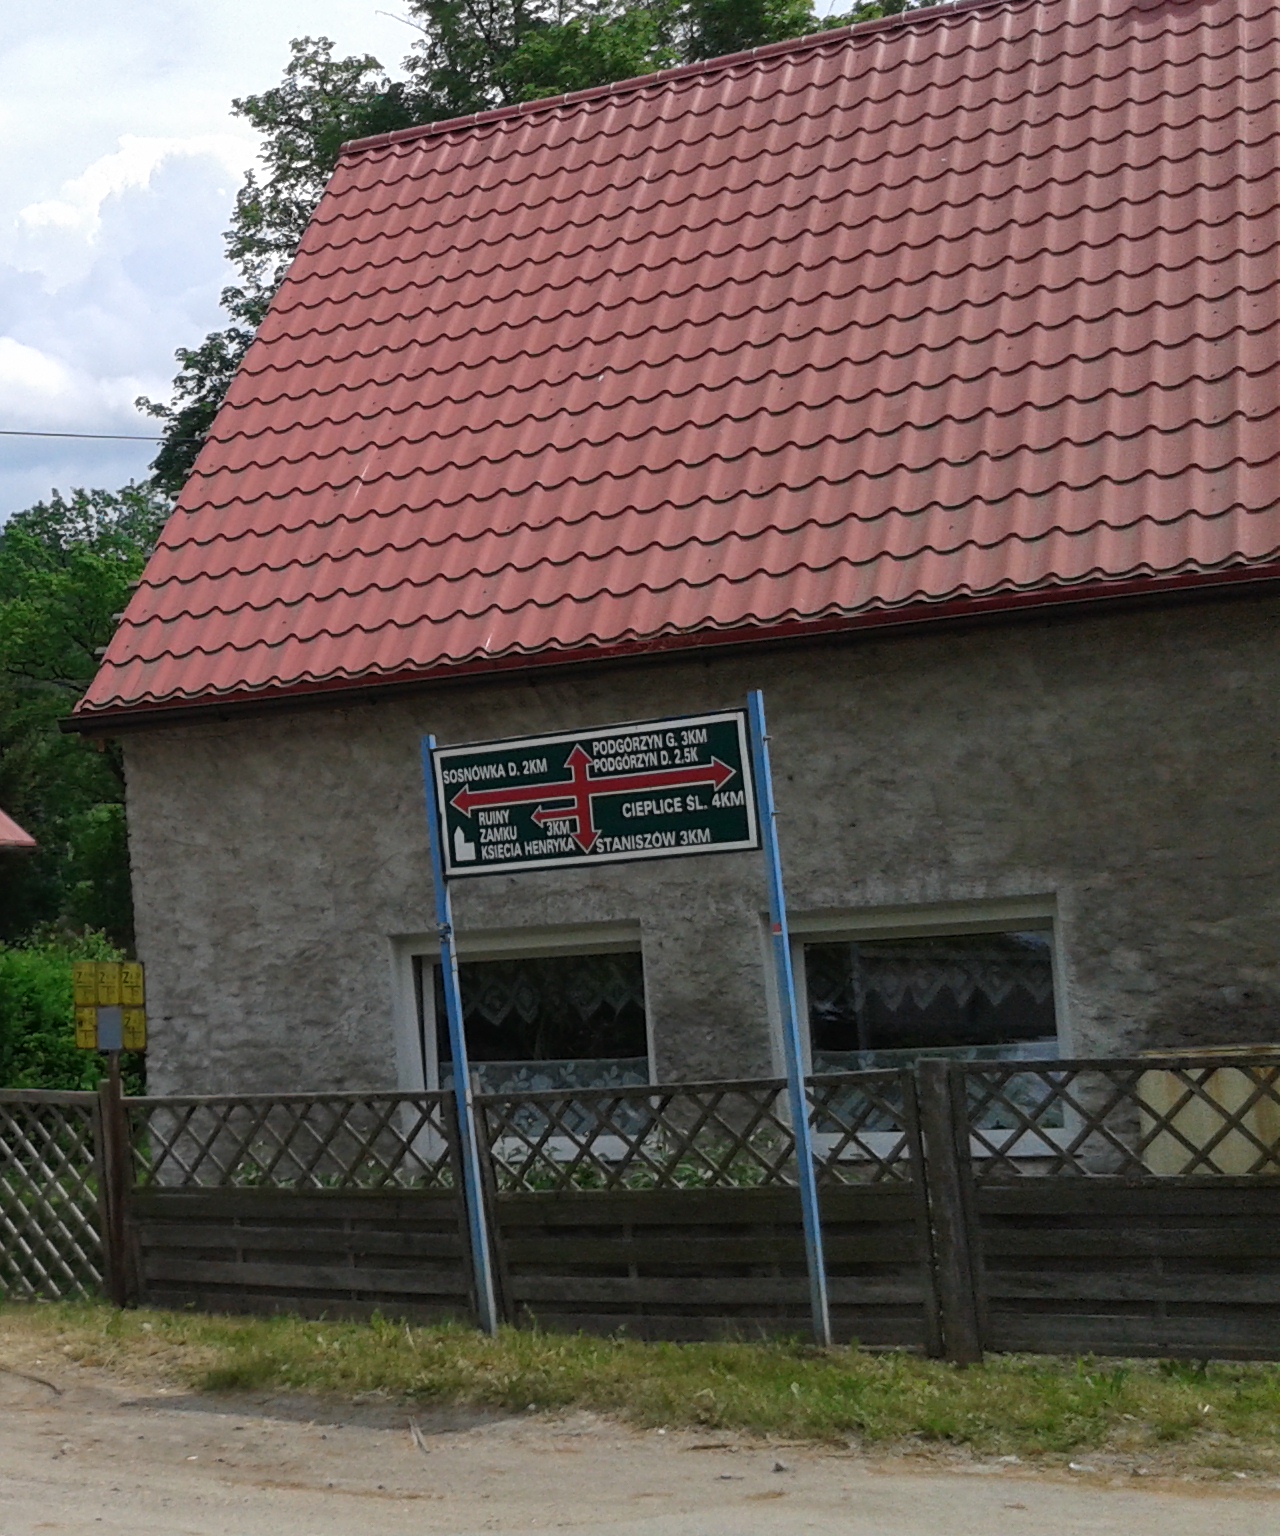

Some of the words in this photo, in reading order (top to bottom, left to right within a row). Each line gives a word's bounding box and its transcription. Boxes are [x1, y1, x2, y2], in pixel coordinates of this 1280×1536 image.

[592, 733, 664, 756] PODGÓRZYN
[665, 732, 679, 748] G.
[681, 728, 708, 746] 3KM
[442, 764, 506, 785] SOSNÓWKA
[507, 761, 520, 777] D.
[522, 757, 548, 775] 2KM
[593, 751, 658, 773] PODGÓRZYN
[660, 751, 672, 766] D.
[622, 797, 683, 818] CIEPLICE
[686, 793, 709, 812] ŚL.
[711, 790, 745, 809] 4KM
[478, 809, 510, 826] RUINY
[546, 820, 571, 837] 3KM
[480, 825, 518, 843] ZAMKU
[596, 830, 677, 853] STANISZÓW
[680, 828, 711, 846] 3KM
[481, 842, 521, 860] KSIĘCIA
[524, 837, 576, 856] HENRYKA
